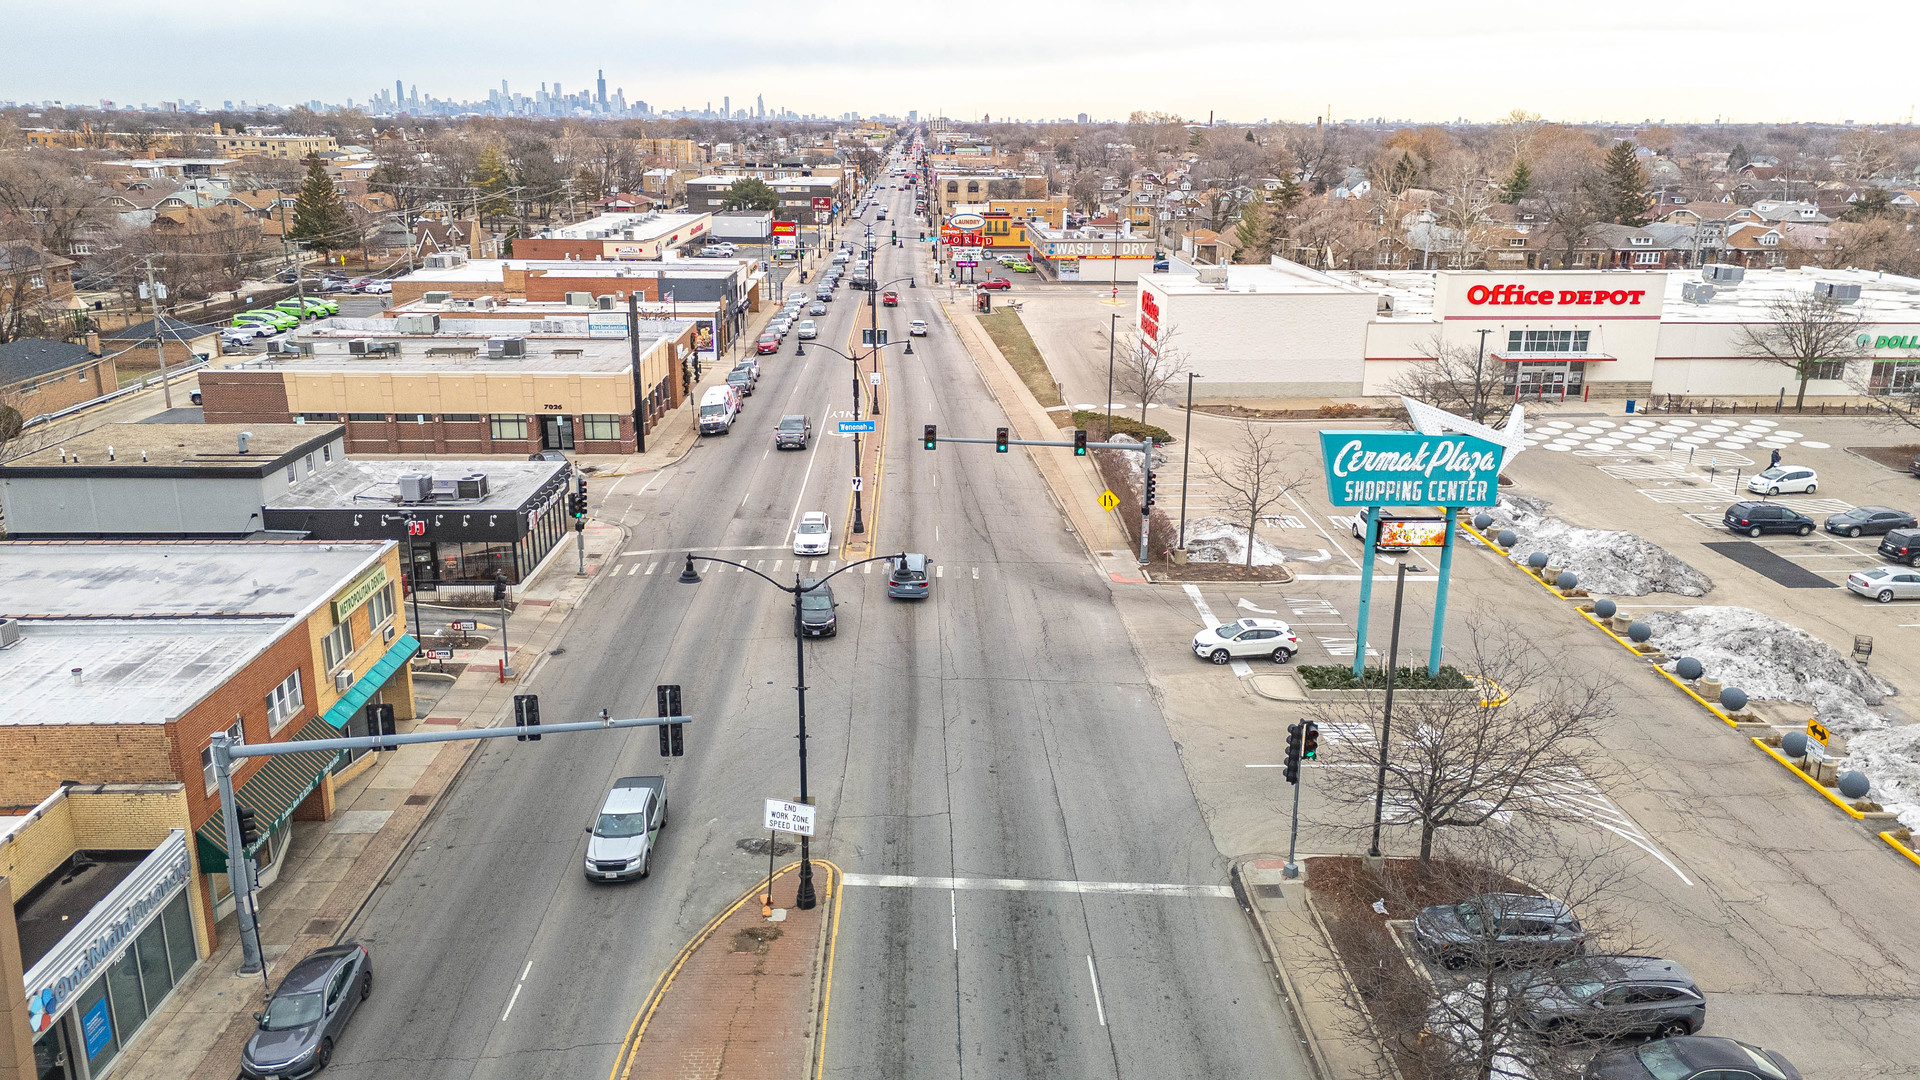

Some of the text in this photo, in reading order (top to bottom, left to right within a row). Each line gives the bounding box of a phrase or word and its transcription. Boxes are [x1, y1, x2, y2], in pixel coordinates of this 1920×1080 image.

[942, 236, 993, 245] WORLD
[1056, 243, 1148, 255] WASH & DRY
[1467, 284, 1646, 305] Office DEPOT
[1875, 335, 1920, 349] DOLL
[1333, 440, 1496, 481] Cermak Plaza
[1344, 480, 1488, 501] SHOPPING CENTER
[340, 570, 385, 615] METROPOLITAN DENTAL
[783, 804, 797, 812] END
[771, 810, 809, 824] WORK ZONE
[769, 820, 810, 832] SPEED LIMIT
[54, 848, 192, 1001] OneMain Financial
